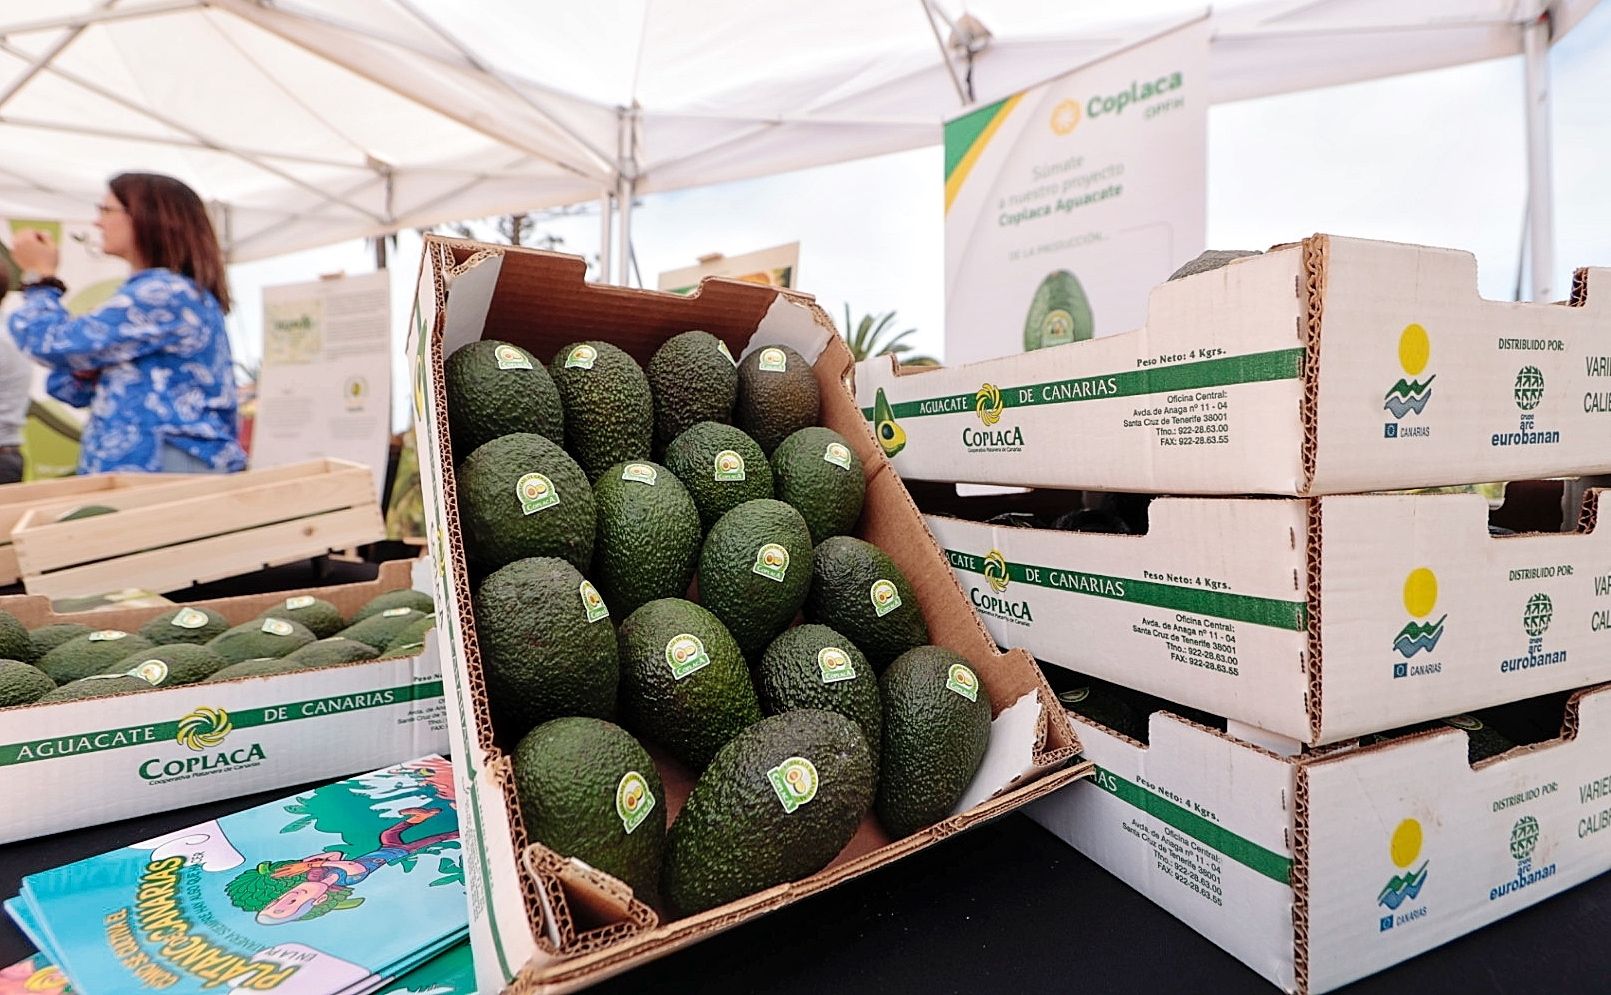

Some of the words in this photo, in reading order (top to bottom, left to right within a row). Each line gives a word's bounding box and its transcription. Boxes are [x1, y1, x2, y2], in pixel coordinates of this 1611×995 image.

[1086, 71, 1183, 118] Coplaca
[1032, 156, 1084, 182] Súmate
[1010, 182, 1059, 204] nuestro
[1062, 163, 1124, 192] proyecto
[999, 203, 1052, 227] Coplaca
[1056, 184, 1123, 213] Aguacate
[1498, 338, 1546, 350] DISTRIBUIDO
[1547, 340, 1564, 351] POR:
[1136, 358, 1157, 368] Peso
[1160, 353, 1186, 364] Neto:
[1189, 350, 1195, 359] 4
[1199, 348, 1227, 359] Kgrs.
[1586, 356, 1611, 377] VARI
[920, 397, 968, 414] AGUACATE
[1019, 388, 1034, 404] DE
[1042, 377, 1118, 401] CANARIAS
[1163, 406, 1188, 416] Anaga
[1201, 403, 1210, 411] 11
[1217, 401, 1228, 410] 04
[1167, 394, 1194, 404] Oficina
[1195, 390, 1228, 401] Central:
[1123, 419, 1142, 428] Santa
[1143, 418, 1159, 426] Cruz
[1160, 416, 1170, 425] de
[1171, 415, 1201, 425] Tenerife
[1203, 413, 1227, 422] 38001
[1400, 426, 1430, 438] CANARIAS
[962, 426, 1025, 447] COPLACA
[1160, 437, 1177, 446] FAX:
[1491, 429, 1560, 446] eurobanan
[1026, 568, 1042, 583] DE
[1050, 571, 1125, 597] CANARIAS
[1143, 570, 1164, 580] Peso
[1166, 573, 1193, 584] Neto:
[1195, 577, 1201, 586] 4
[1204, 578, 1232, 590] Kgrs.
[1509, 567, 1555, 581] DISTRIBUIDO
[1557, 565, 1574, 577] POR:
[970, 587, 1033, 622] COPLACA
[1142, 617, 1161, 628] Avda.
[1162, 622, 1171, 630] de
[1173, 624, 1197, 636] Anaga
[1209, 631, 1218, 640] 11
[1225, 635, 1236, 644] 04
[1175, 613, 1202, 626] Oficina
[1203, 619, 1235, 633] Central:
[1132, 625, 1152, 636] Santa
[1153, 629, 1169, 640] Cruz
[1170, 633, 1180, 642] de
[1181, 635, 1211, 649] Tenerife
[1212, 642, 1236, 655] 38001
[1171, 652, 1188, 663] FAX:
[1410, 662, 1442, 676] CANARIAS
[1501, 650, 1567, 673] eurobanan
[17, 726, 156, 761] AGUACATE
[264, 706, 288, 722] DE
[301, 690, 394, 716] CANARIAS
[139, 743, 266, 780] COPLACA
[1136, 775, 1155, 790] Peso
[1158, 786, 1183, 803] Neto:
[1194, 803, 1220, 822] Kgrs.
[1492, 787, 1540, 813] DISTRIBUIDO
[1122, 822, 1140, 838] Santa
[1141, 833, 1157, 847] Cruz
[1158, 843, 1167, 853] de
[1169, 849, 1196, 870] Tenerife
[1198, 865, 1221, 884] 38001
[1151, 830, 1160, 840] de
[1161, 835, 1183, 853] Anaga
[1196, 855, 1204, 864] 11
[1211, 863, 1221, 874] 04
[1164, 827, 1189, 847] Oficina
[1191, 842, 1222, 863] Central:
[1490, 863, 1556, 901] eurobanan
[136, 857, 187, 944] CANARIAS
[1396, 906, 1428, 926] CANARIAS
[107, 919, 139, 959] CULTIVA
